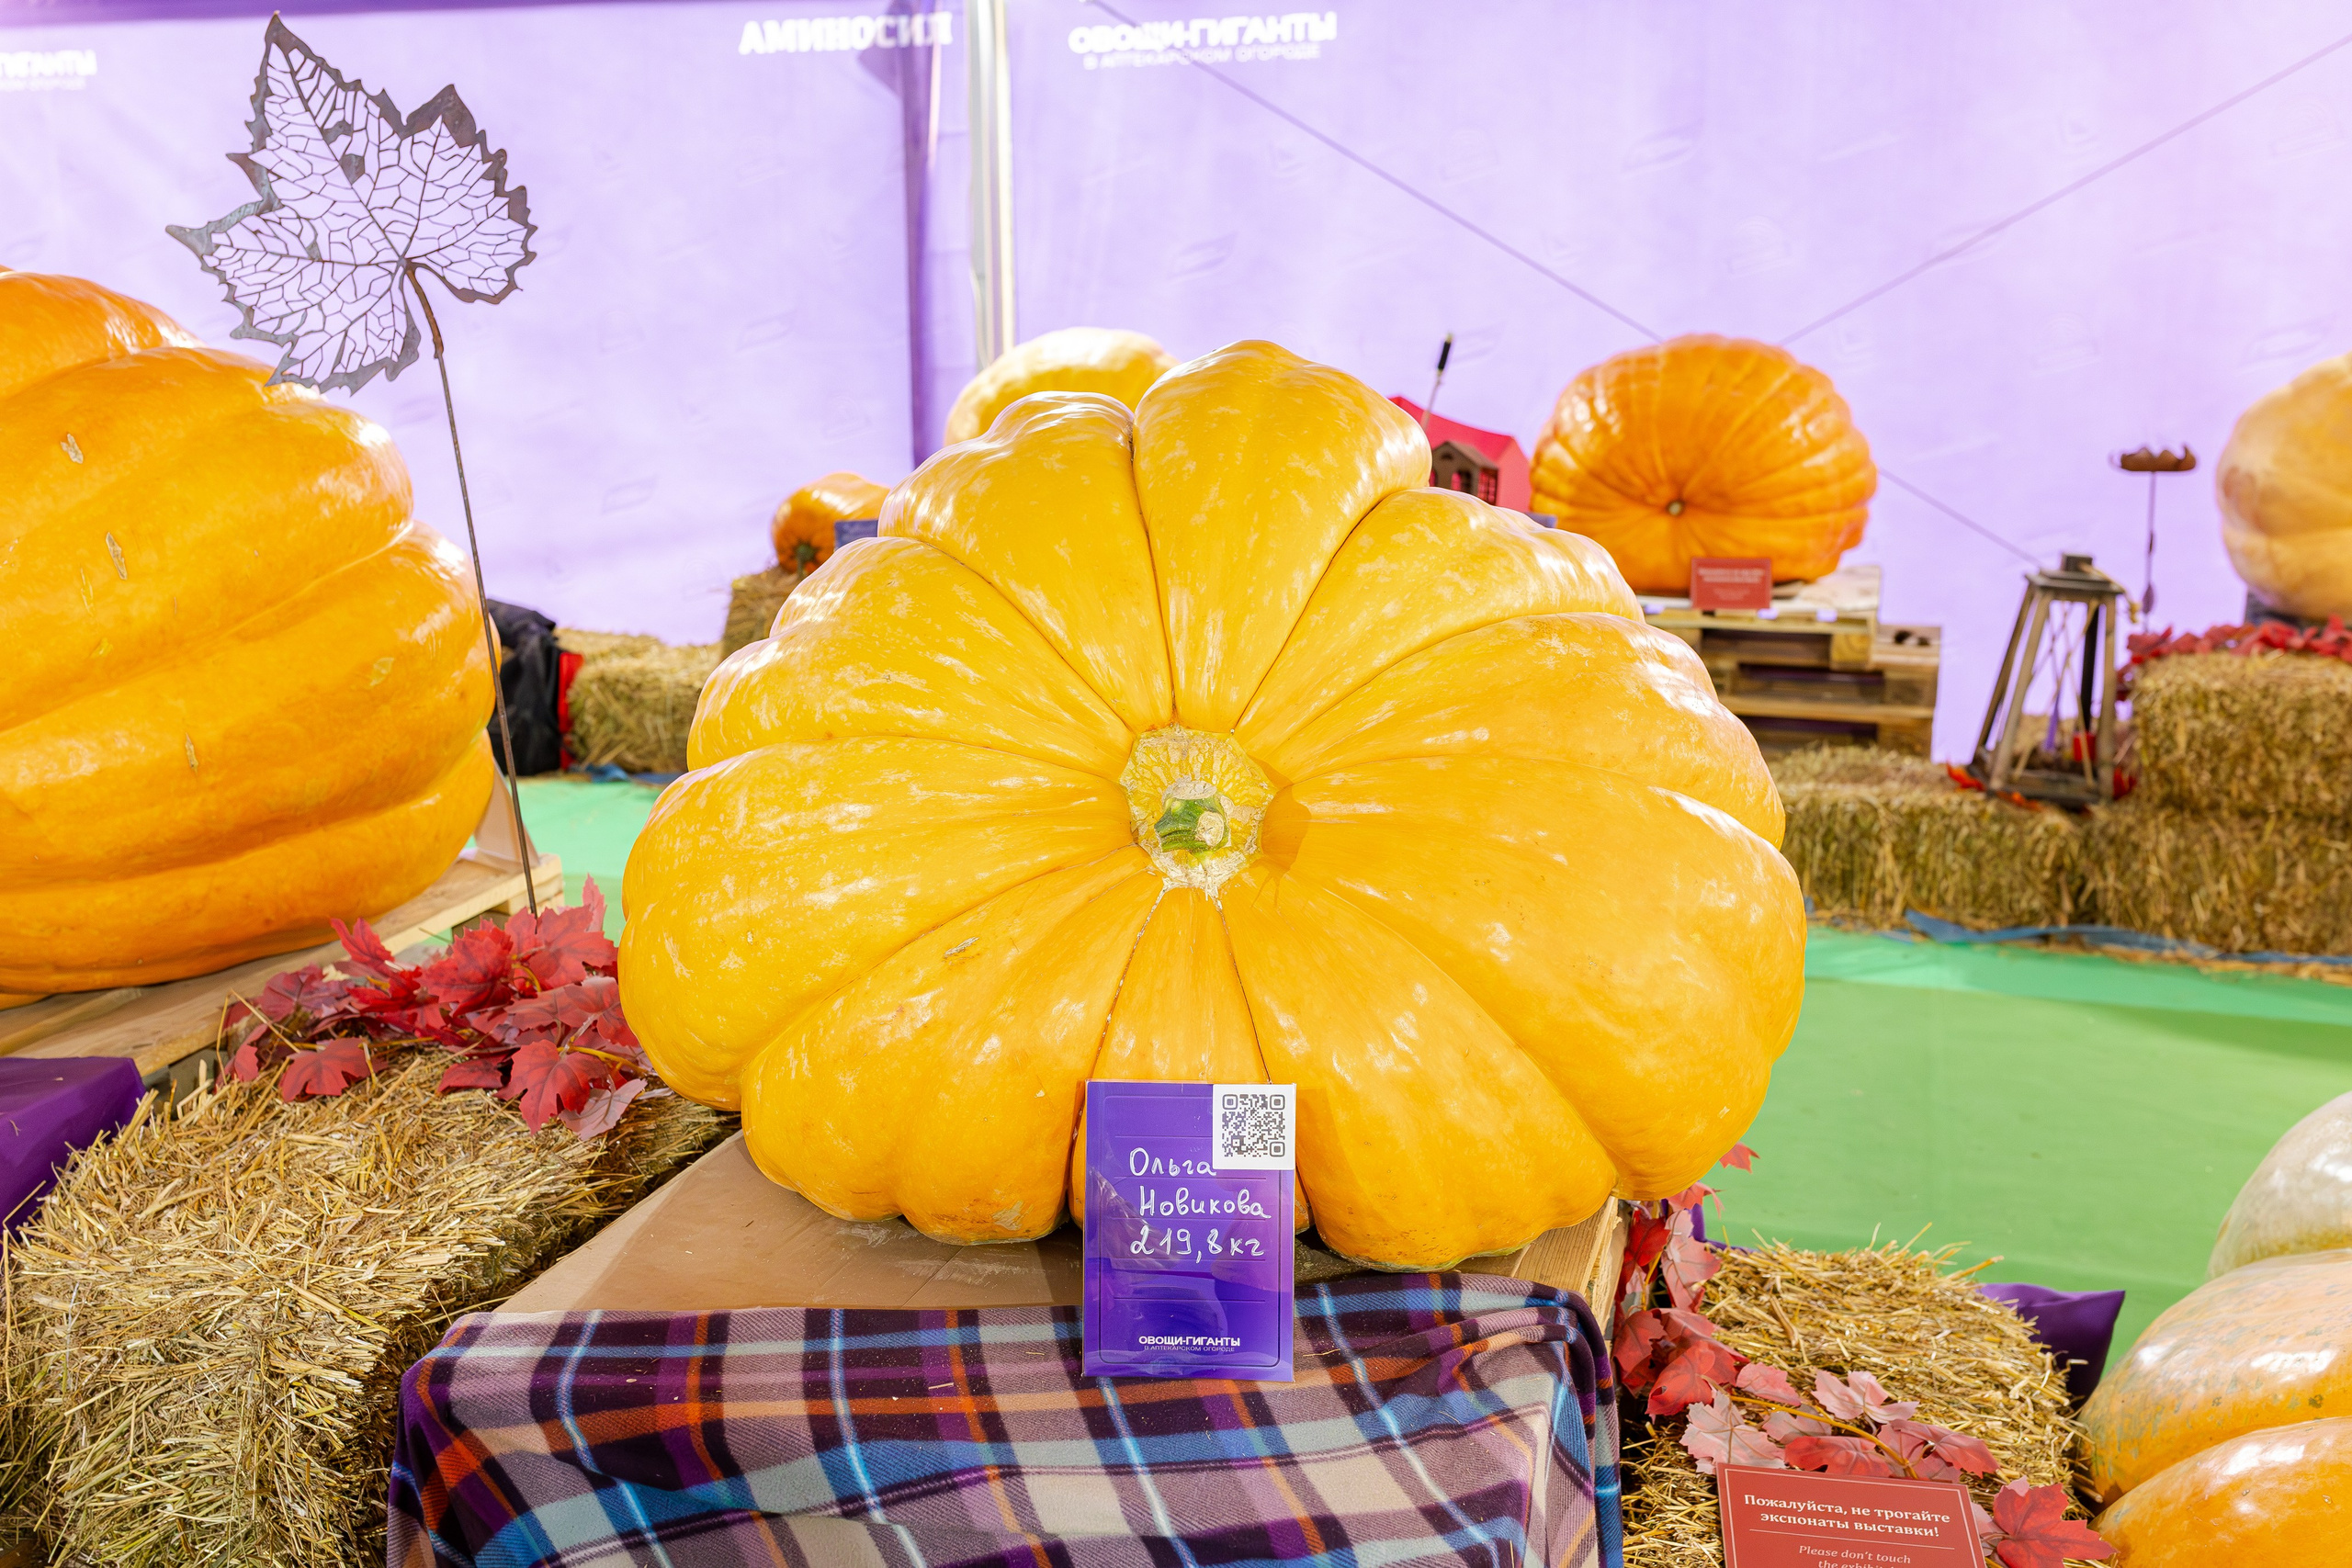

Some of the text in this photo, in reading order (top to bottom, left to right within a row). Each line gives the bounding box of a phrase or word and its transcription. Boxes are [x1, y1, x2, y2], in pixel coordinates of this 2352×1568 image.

[738, 12, 954, 55] АМИНОСИЛ
[1068, 11, 1337, 53] ОВОЩИ-ГИГАНТЫ
[1129, 1147, 1217, 1177] Ольга
[1139, 1185, 1272, 1219] Новикова
[1138, 1336, 1240, 1347] ОВОЩИ-ГИГАНТЫ
[1744, 1494, 1951, 1523] Пожалуйста, не трогайте
[1760, 1513, 1939, 1537] экспонаты выставки!
[1799, 1545, 1911, 1564] Please don't touch
[1818, 1560, 1838, 1568] the
